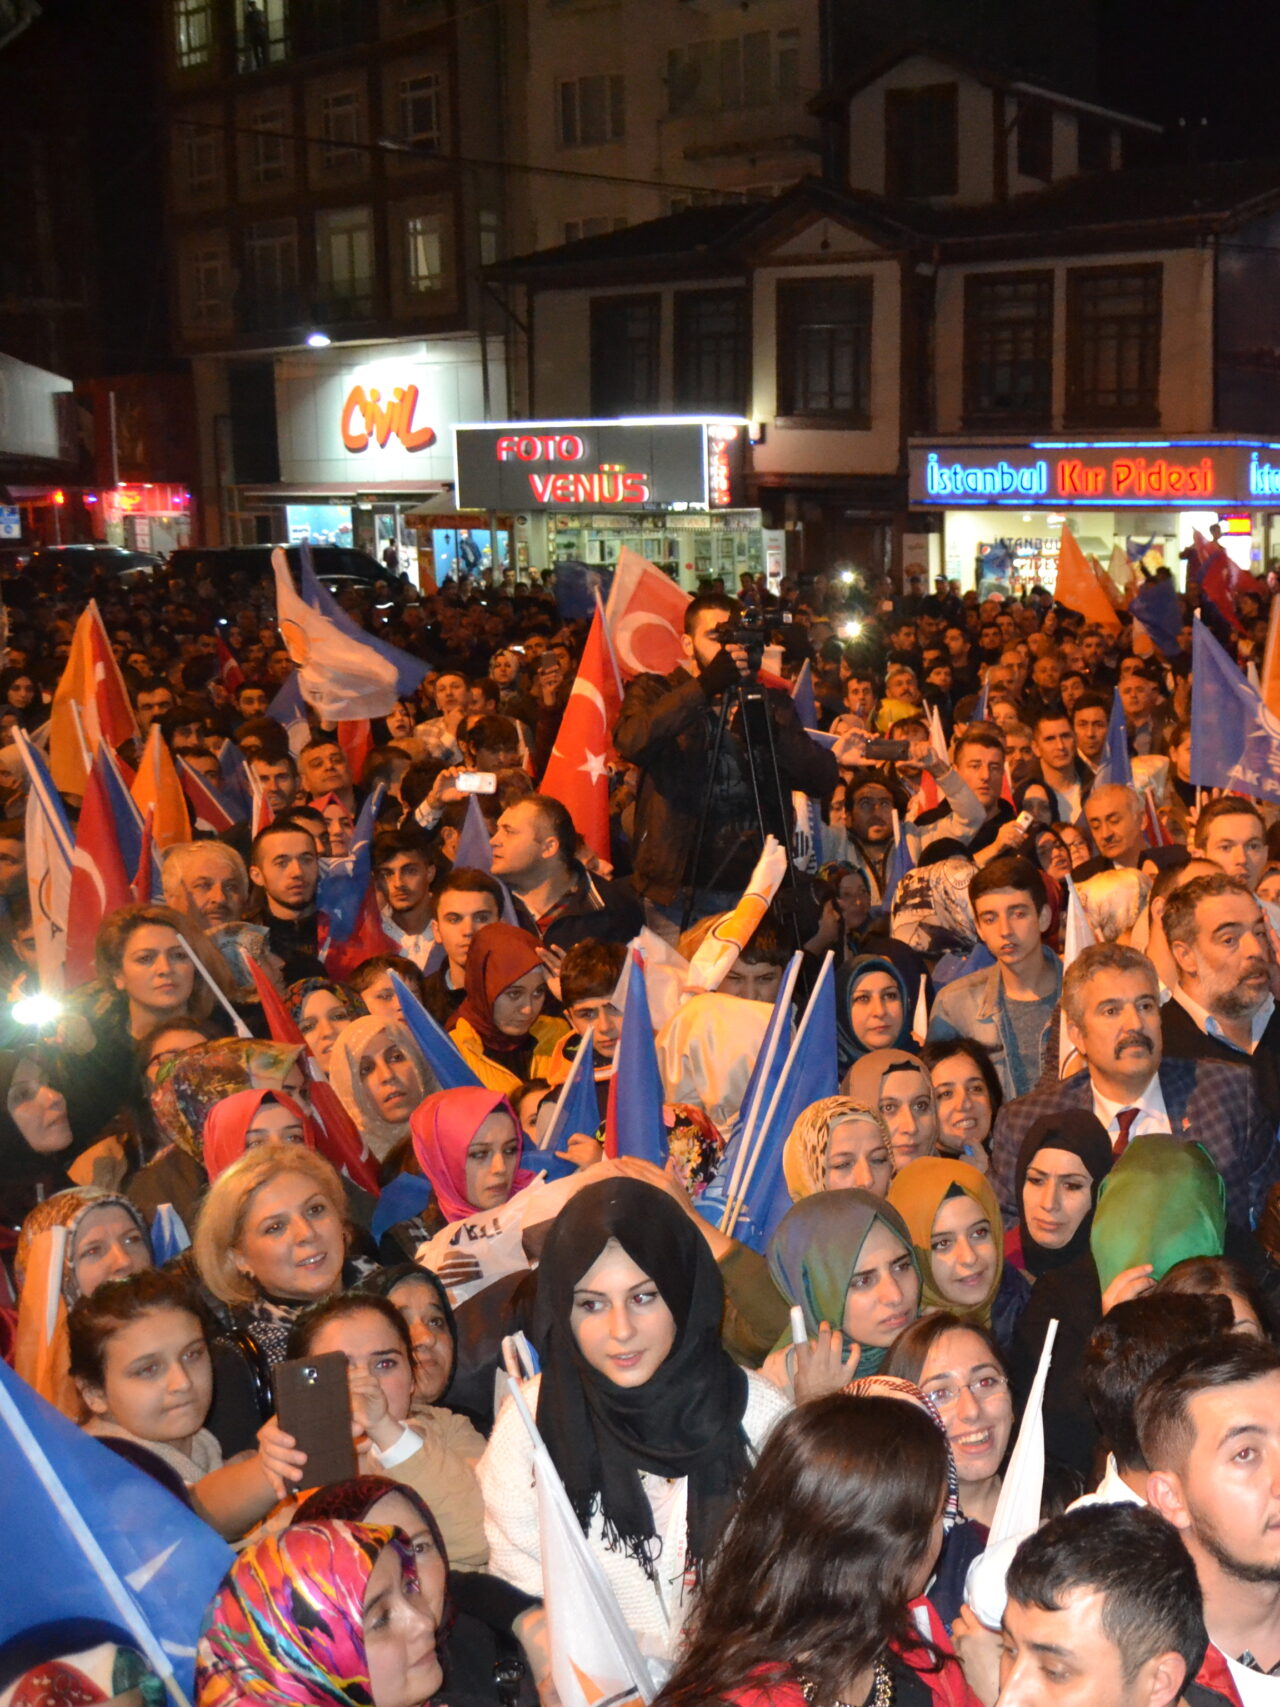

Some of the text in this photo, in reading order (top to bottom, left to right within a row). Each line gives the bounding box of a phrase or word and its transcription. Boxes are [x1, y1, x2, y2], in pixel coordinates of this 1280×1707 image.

[496, 434, 585, 462] FOTO
[528, 464, 650, 503] VENÜS
[927, 452, 1214, 497] İstanbul Kır Pidesi
